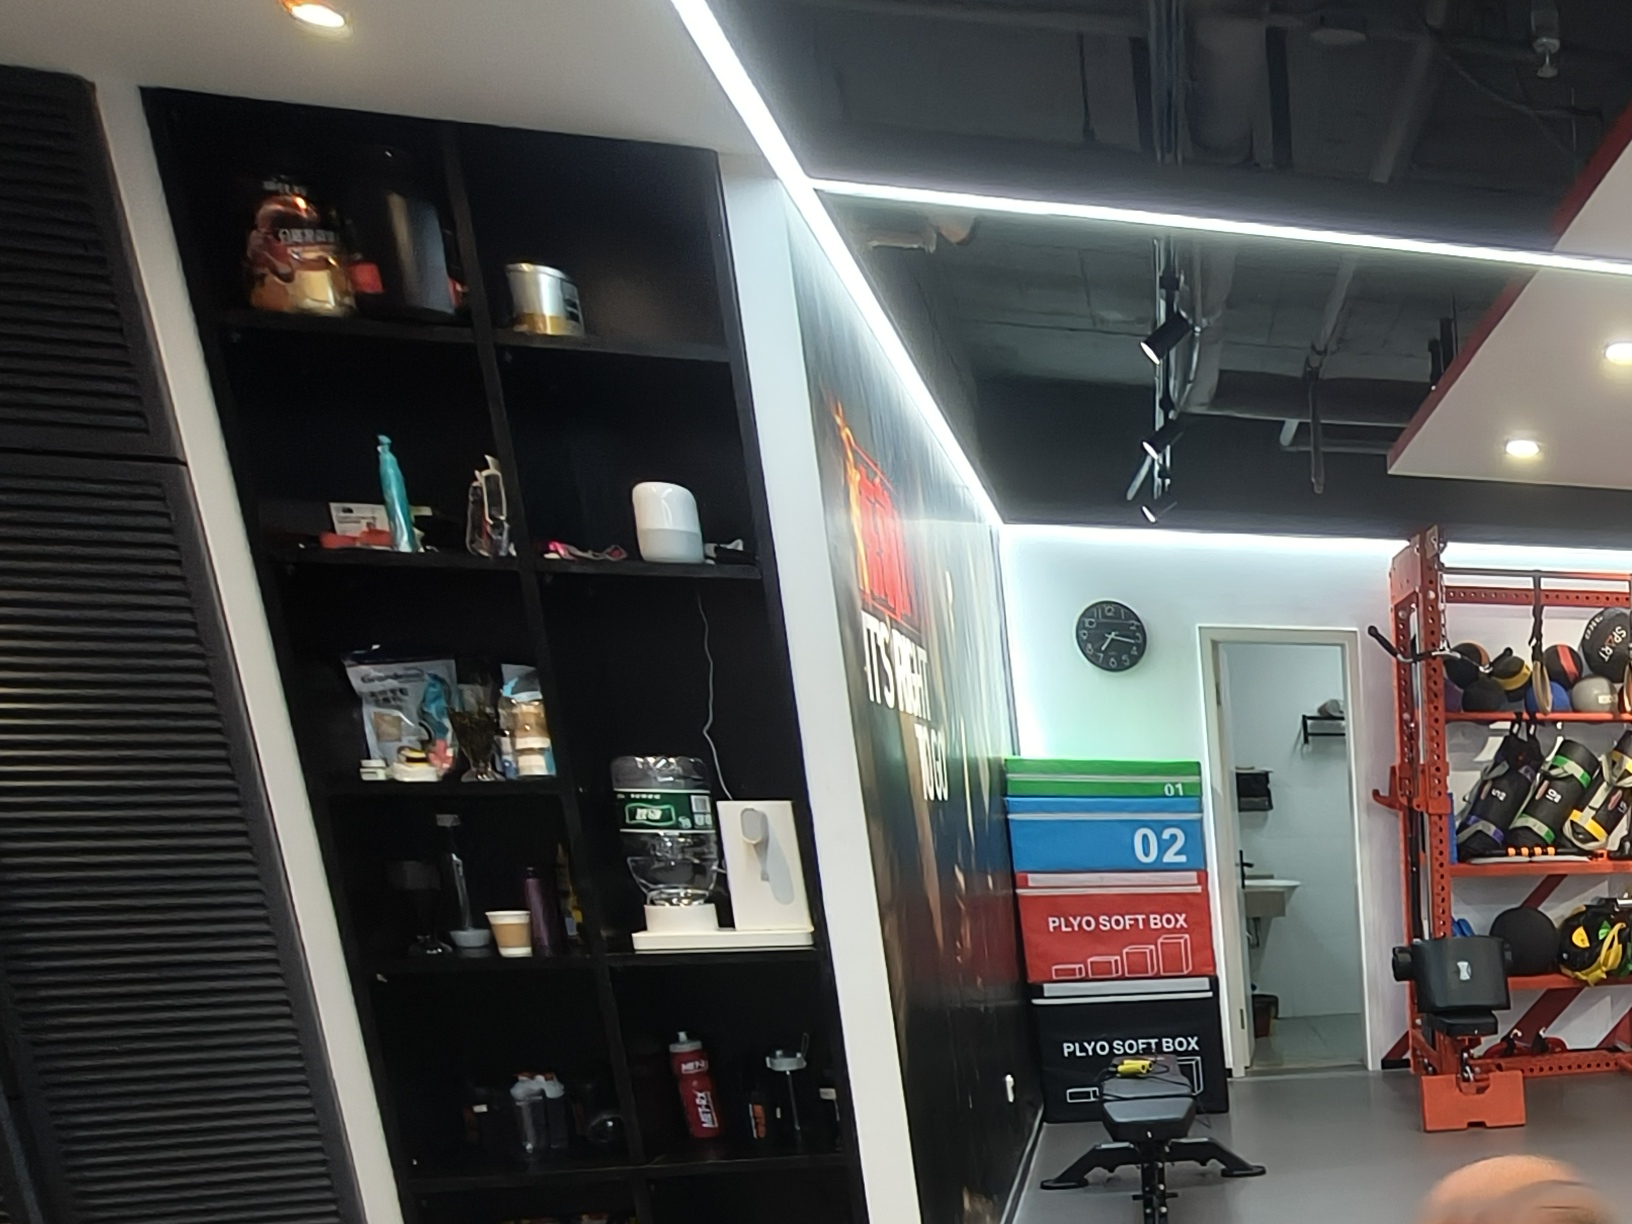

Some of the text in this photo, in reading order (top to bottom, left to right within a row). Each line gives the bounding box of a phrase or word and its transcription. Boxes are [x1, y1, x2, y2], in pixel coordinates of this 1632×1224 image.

[1163, 783, 1184, 796] 01
[1134, 827, 1187, 863] 02
[1048, 913, 1188, 932] PLYO SOFT BOX
[1063, 1036, 1199, 1057] PLYO SOFT BOX
